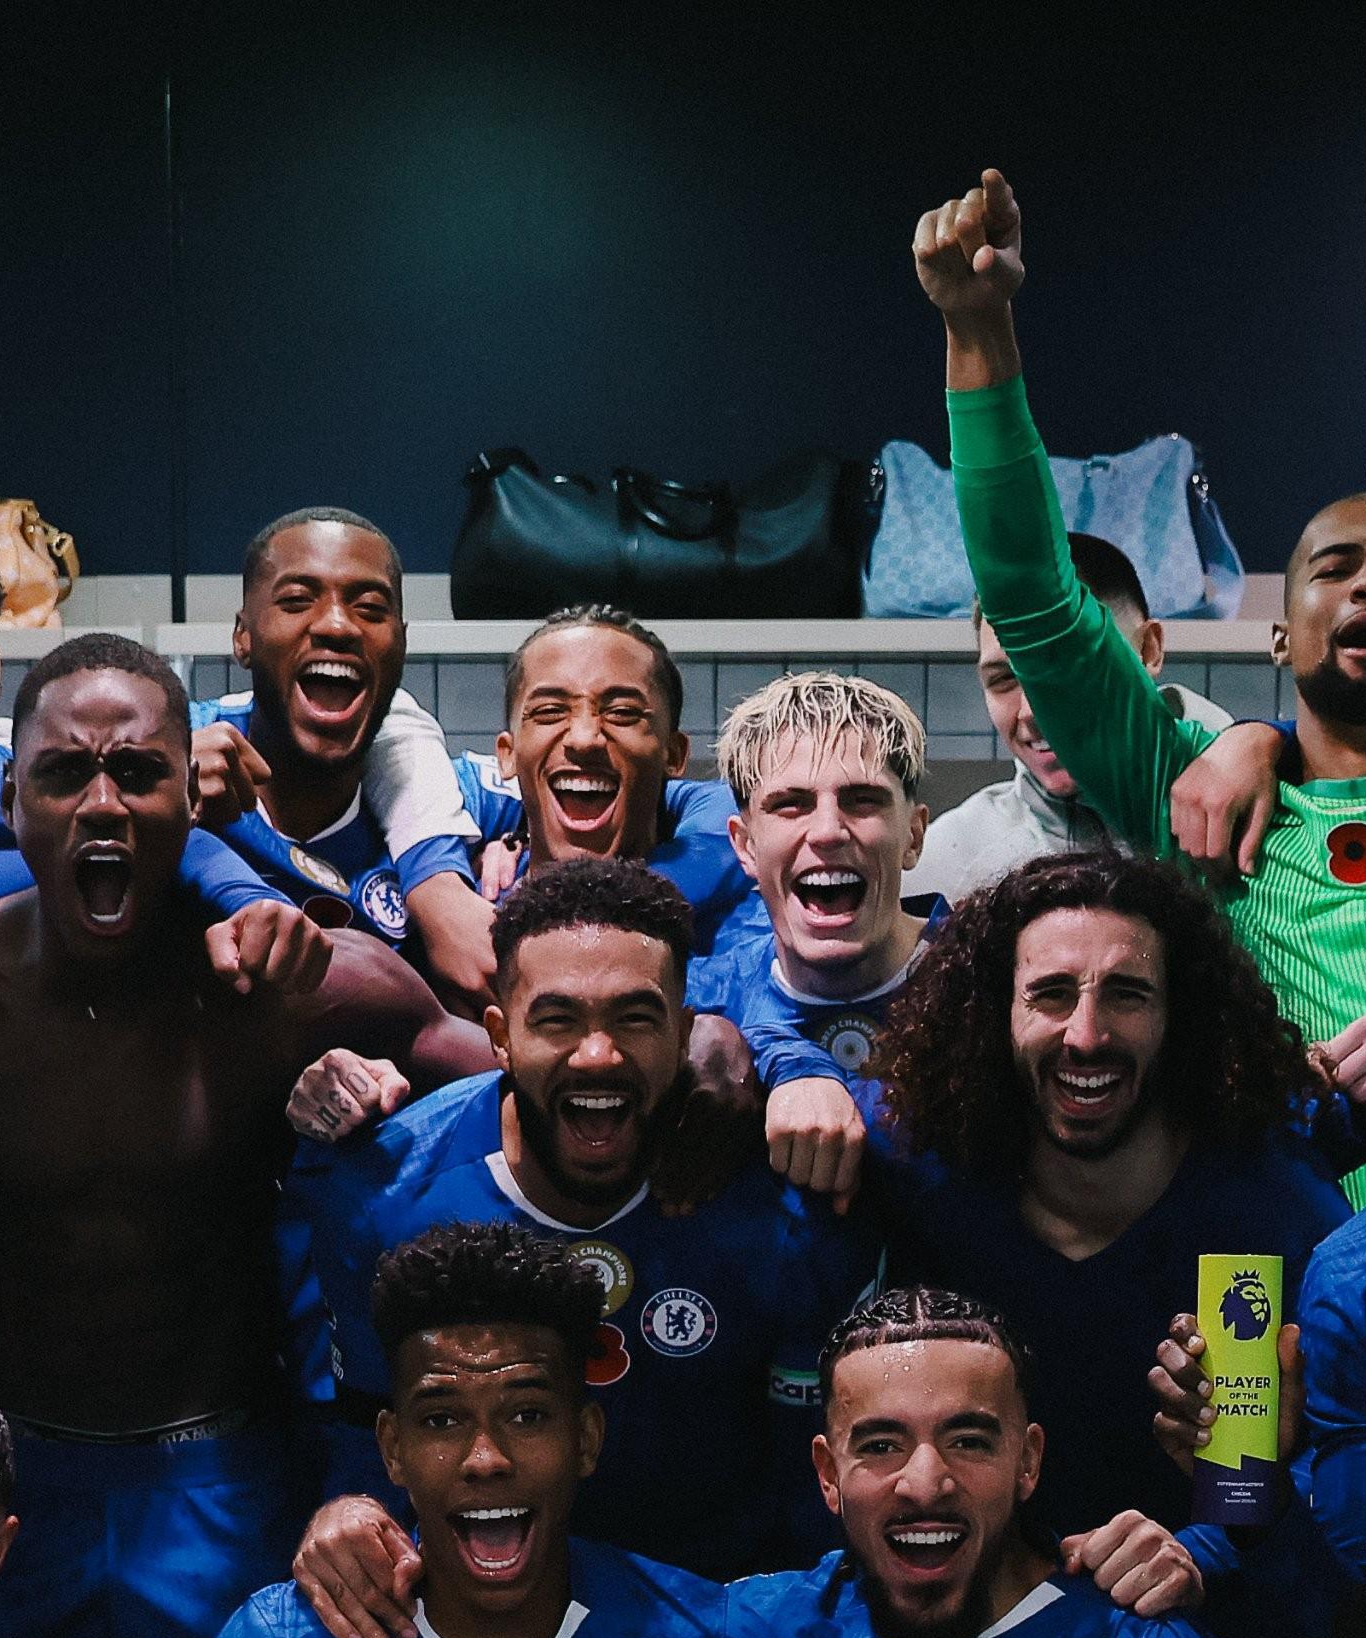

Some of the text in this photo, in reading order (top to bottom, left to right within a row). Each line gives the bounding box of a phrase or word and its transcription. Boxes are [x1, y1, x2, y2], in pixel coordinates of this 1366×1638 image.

[1215, 1376, 1271, 1389] PLAYER
[1229, 1392, 1259, 1400] OF THE
[1216, 1404, 1268, 1416] MATCH
